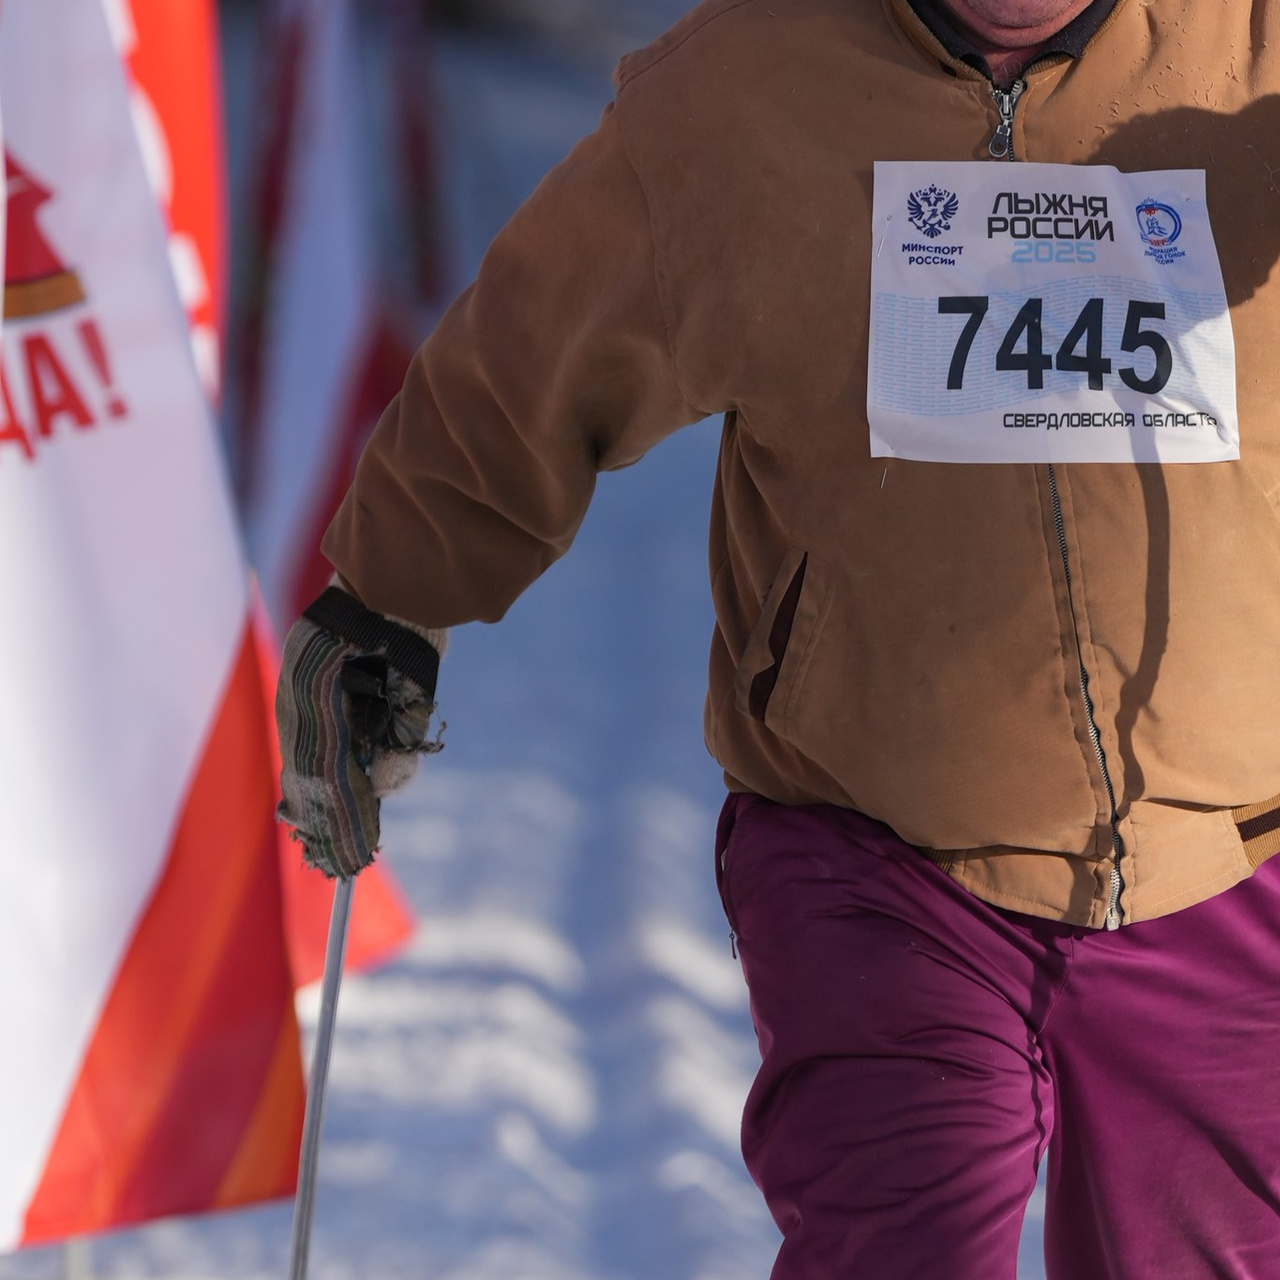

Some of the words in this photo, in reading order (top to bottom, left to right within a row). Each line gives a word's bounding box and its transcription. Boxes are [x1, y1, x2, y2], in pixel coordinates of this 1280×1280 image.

[992, 192, 1108, 218] ЛЫЖНЯ
[987, 216, 1115, 242] РОССИИ
[901, 243, 964, 255] МИНСПОРТ
[1011, 240, 1096, 263] 2025
[908, 256, 956, 266] РОССИИ
[937, 296, 1173, 395] 7445
[1003, 412, 1135, 430] СВЕРДЛОВСКАЯ
